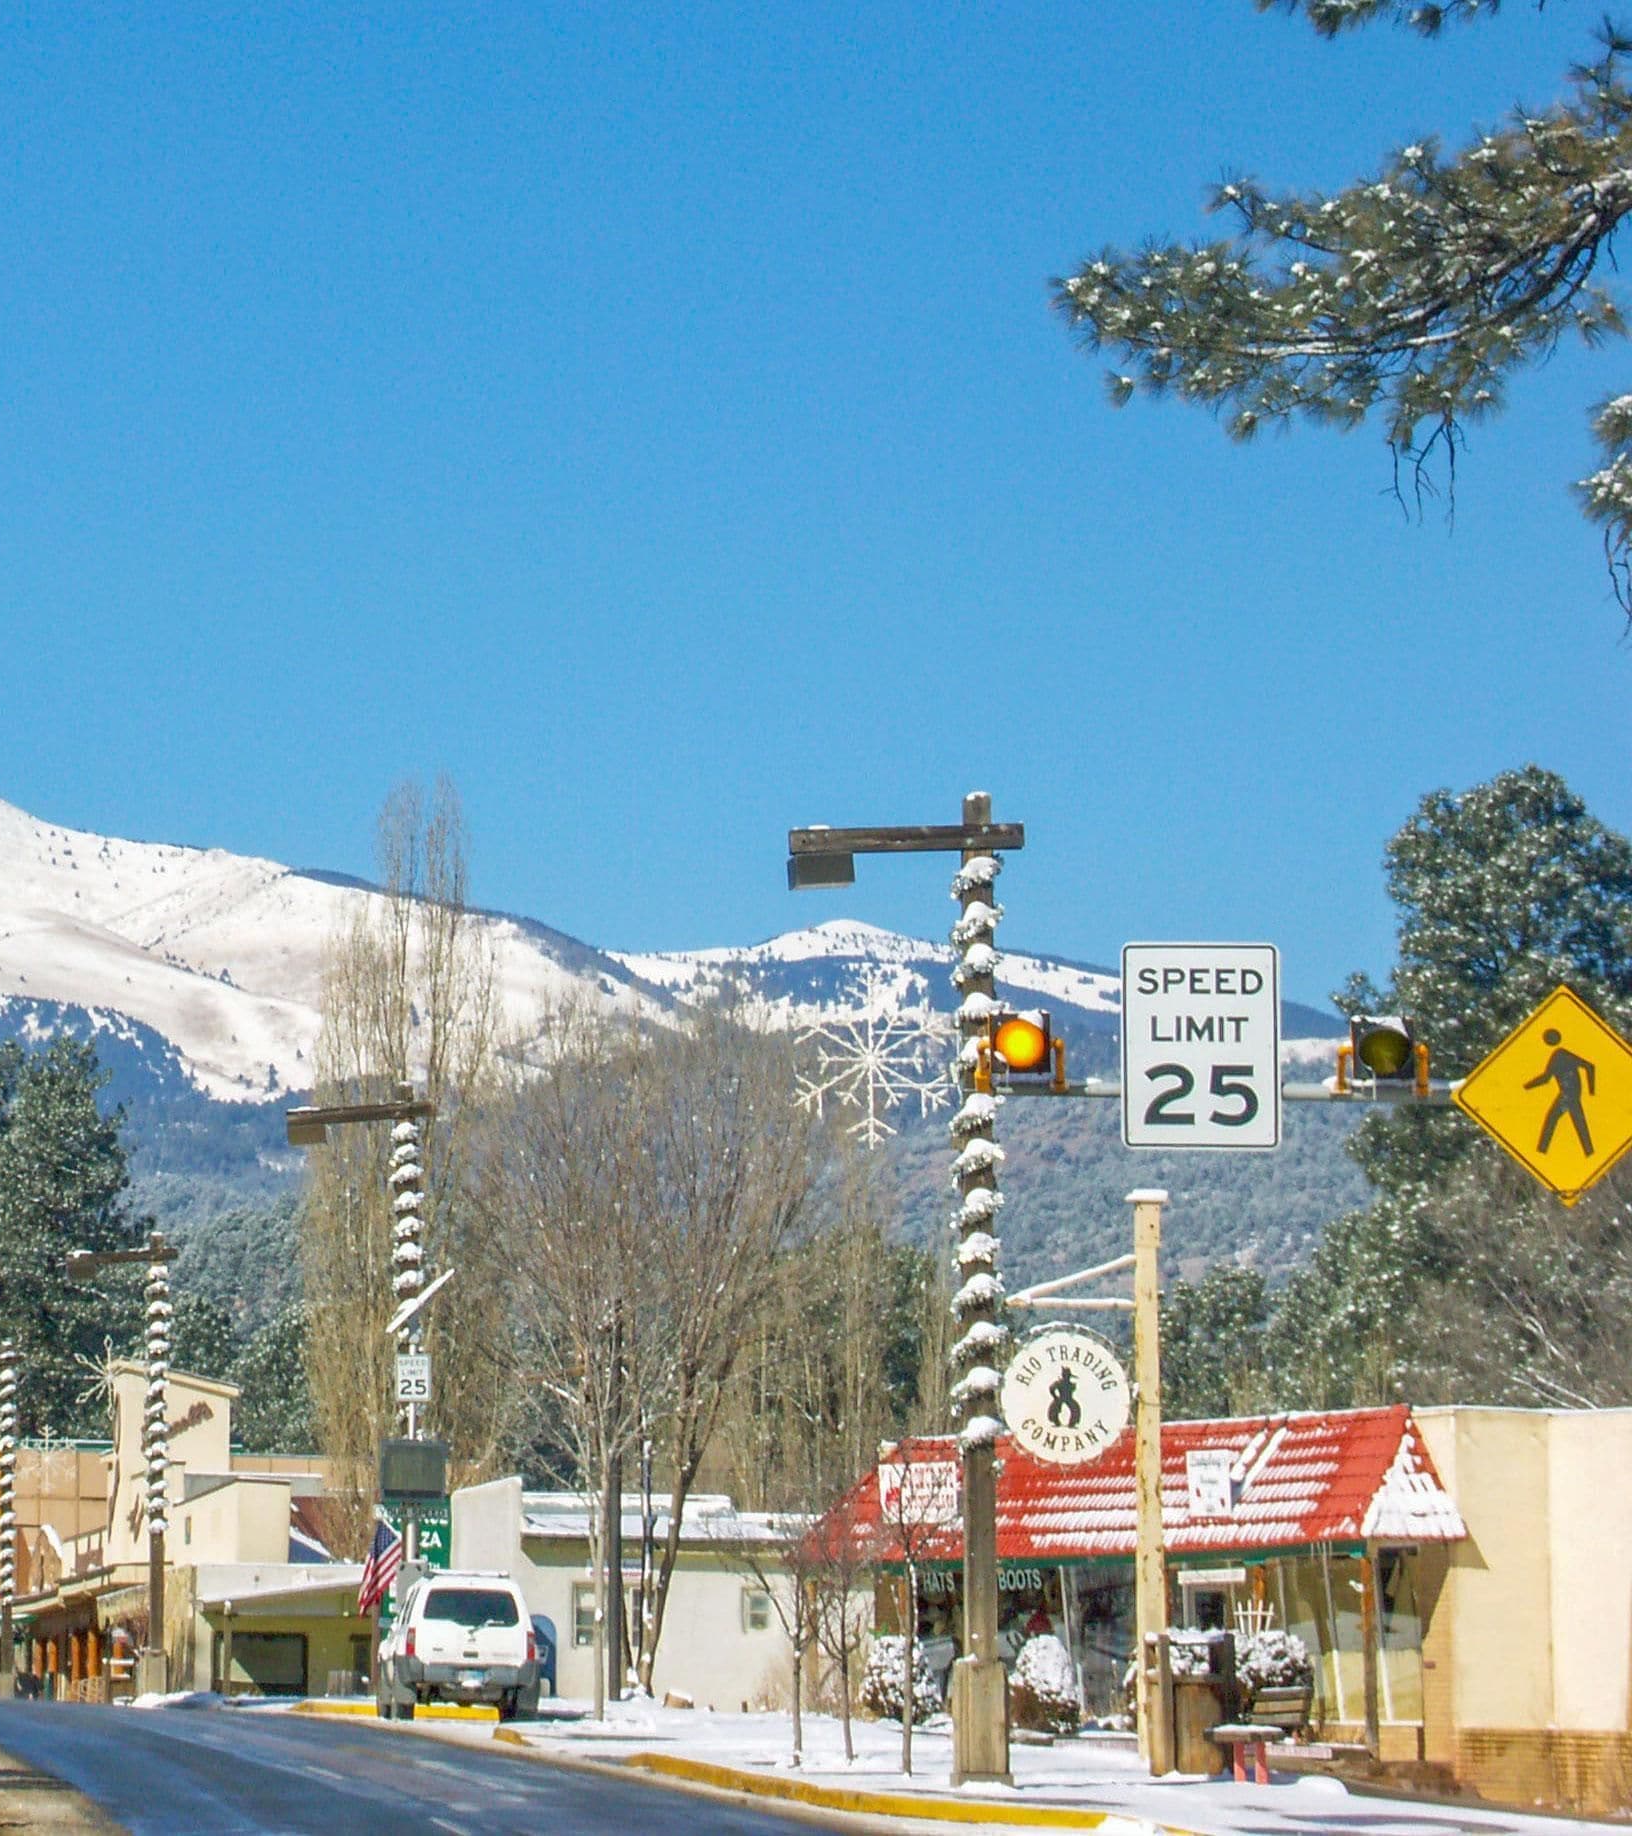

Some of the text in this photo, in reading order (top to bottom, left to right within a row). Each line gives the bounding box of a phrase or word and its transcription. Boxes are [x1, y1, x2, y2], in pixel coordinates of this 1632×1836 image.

[1137, 967, 1263, 995] SPEED
[1151, 1015, 1249, 1042] LIMIT
[1144, 1062, 1259, 1127] 25
[1016, 1344, 1118, 1391] RIO TRADING
[400, 1379, 427, 1395] 25
[1021, 1418, 1110, 1453] COMPANY
[922, 1568, 1042, 1592] HATS BOOTS
